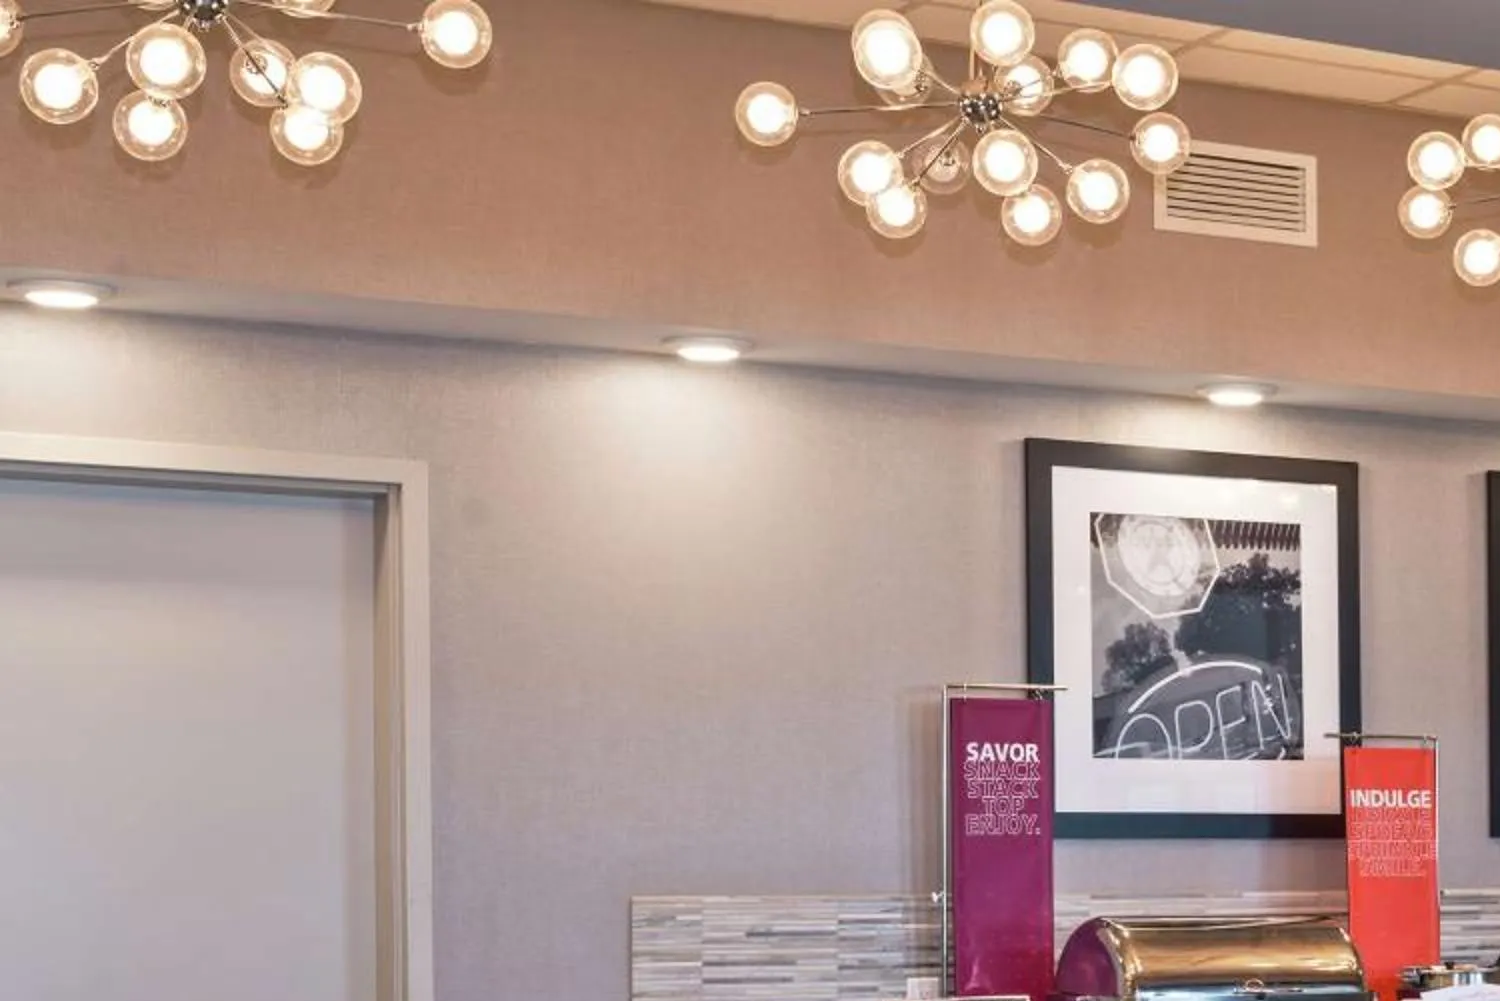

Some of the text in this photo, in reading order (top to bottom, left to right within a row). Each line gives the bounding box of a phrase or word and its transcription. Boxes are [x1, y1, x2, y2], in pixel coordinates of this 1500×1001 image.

[1116, 673, 1291, 760] OPEN
[966, 742, 1039, 762] SAVOR
[964, 761, 1040, 780] SNACK
[967, 779, 1039, 798] STACK
[982, 797, 1025, 815] TOP
[1350, 789, 1433, 808] INDULGE
[965, 814, 1041, 835] ENJOY.
